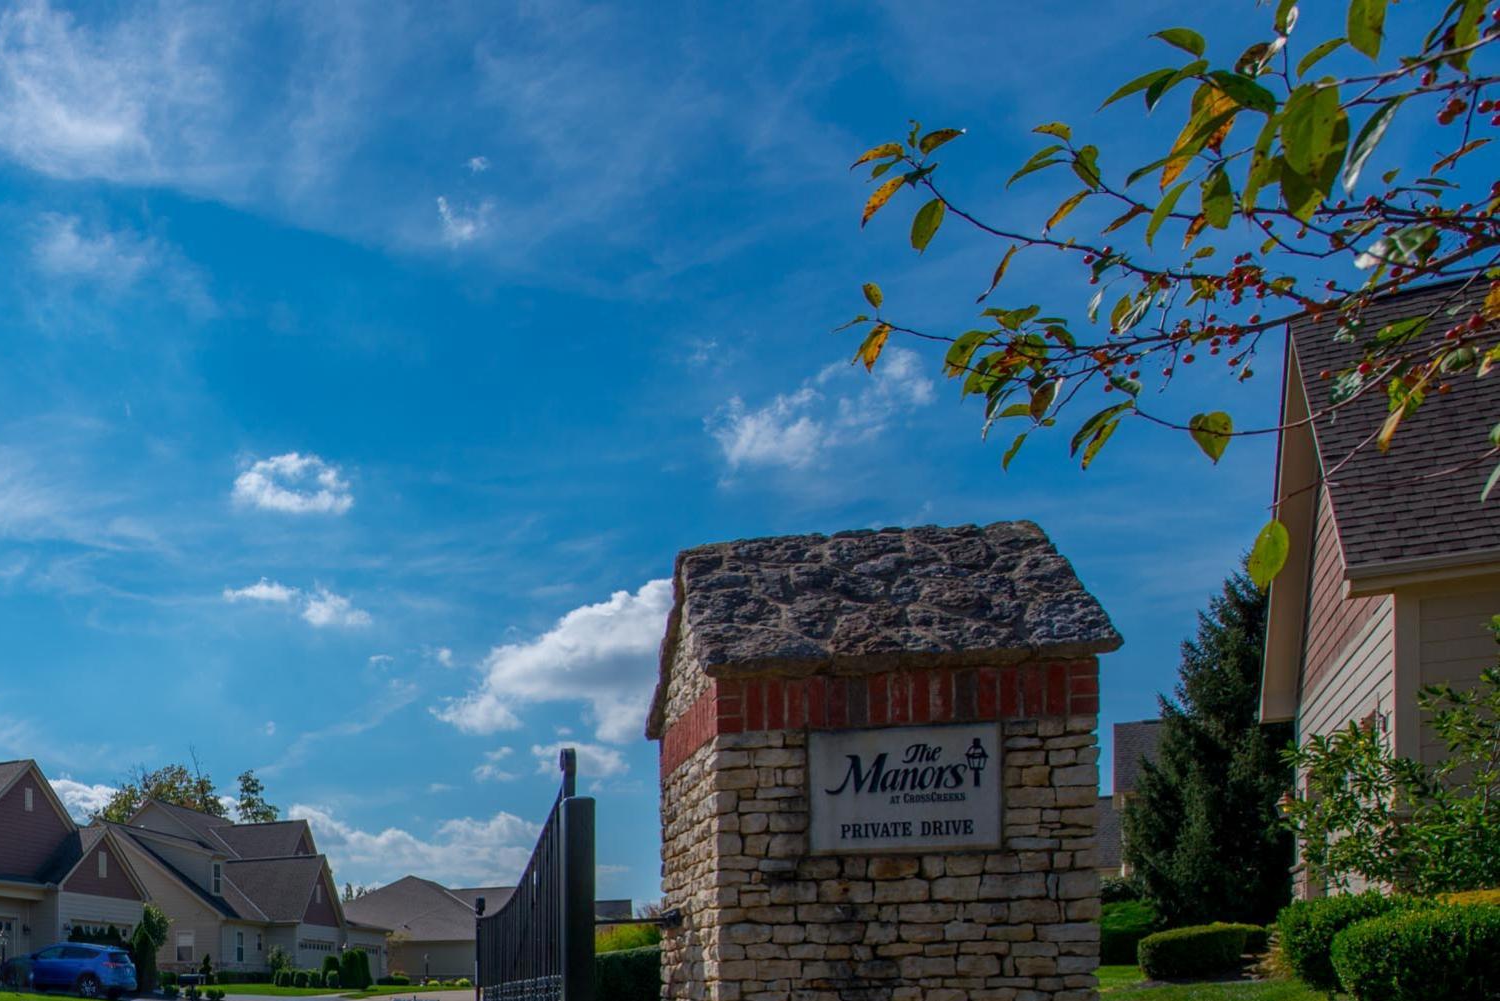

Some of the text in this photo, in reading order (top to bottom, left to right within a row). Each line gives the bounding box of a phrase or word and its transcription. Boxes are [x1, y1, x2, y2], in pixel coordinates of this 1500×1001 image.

[902, 743, 943, 764] The
[825, 752, 968, 795] Manors
[841, 819, 974, 839] PRIVATE DRIVE
